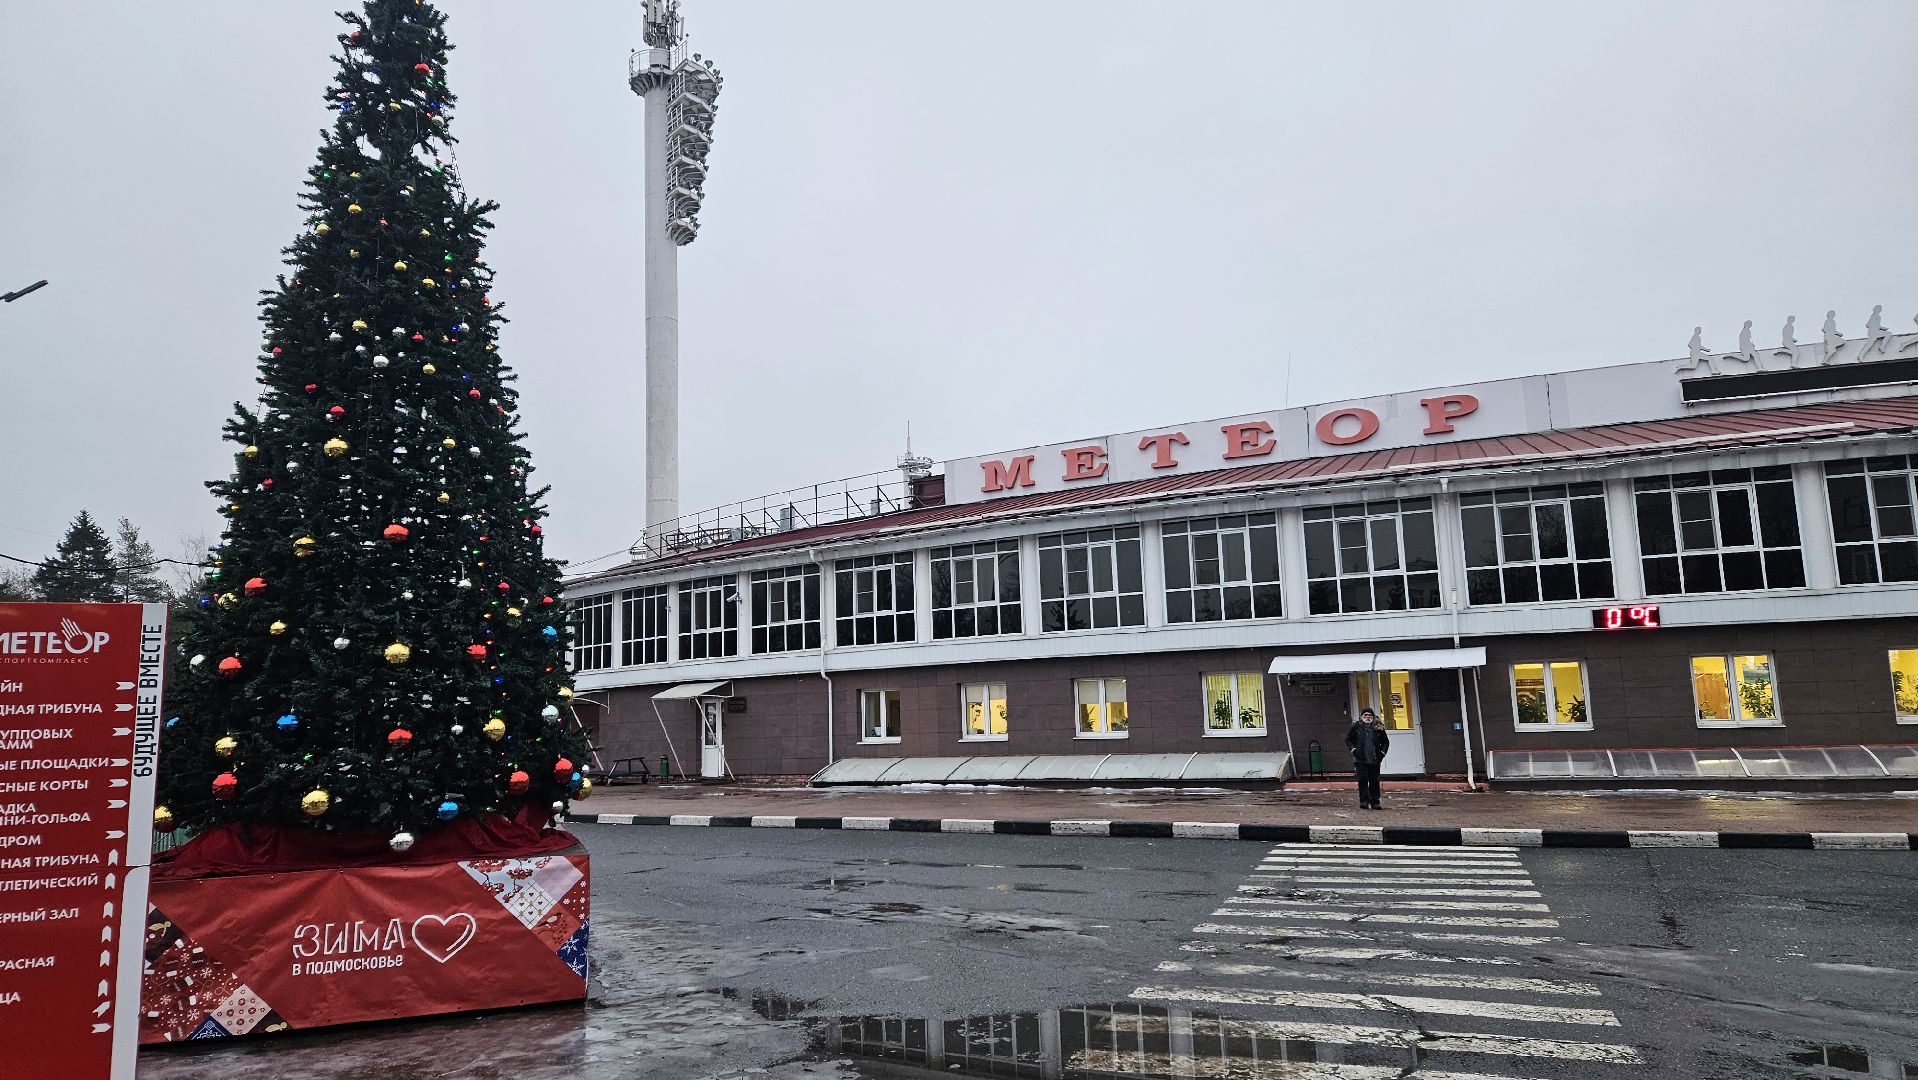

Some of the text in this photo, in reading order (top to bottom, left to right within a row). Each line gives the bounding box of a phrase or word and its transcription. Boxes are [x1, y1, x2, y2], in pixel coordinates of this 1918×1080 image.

[980, 394, 1479, 492] МЕТЕОР
[133, 624, 162, 777] БУДУЩЕЕ ВМЕСТЕ
[38, 703, 102, 715] ТРИБУНА
[0, 728, 73, 740] УППОВЫХ
[21, 757, 109, 770] ПЛОЩАДКИ
[40, 779, 89, 791] КОРТЫ
[0, 812, 91, 826] НИ-ГОЛЬФА
[34, 854, 99, 866] ТРИБУНА
[50, 908, 79, 920] ЗАЛ
[292, 917, 405, 958] ЗИМА
